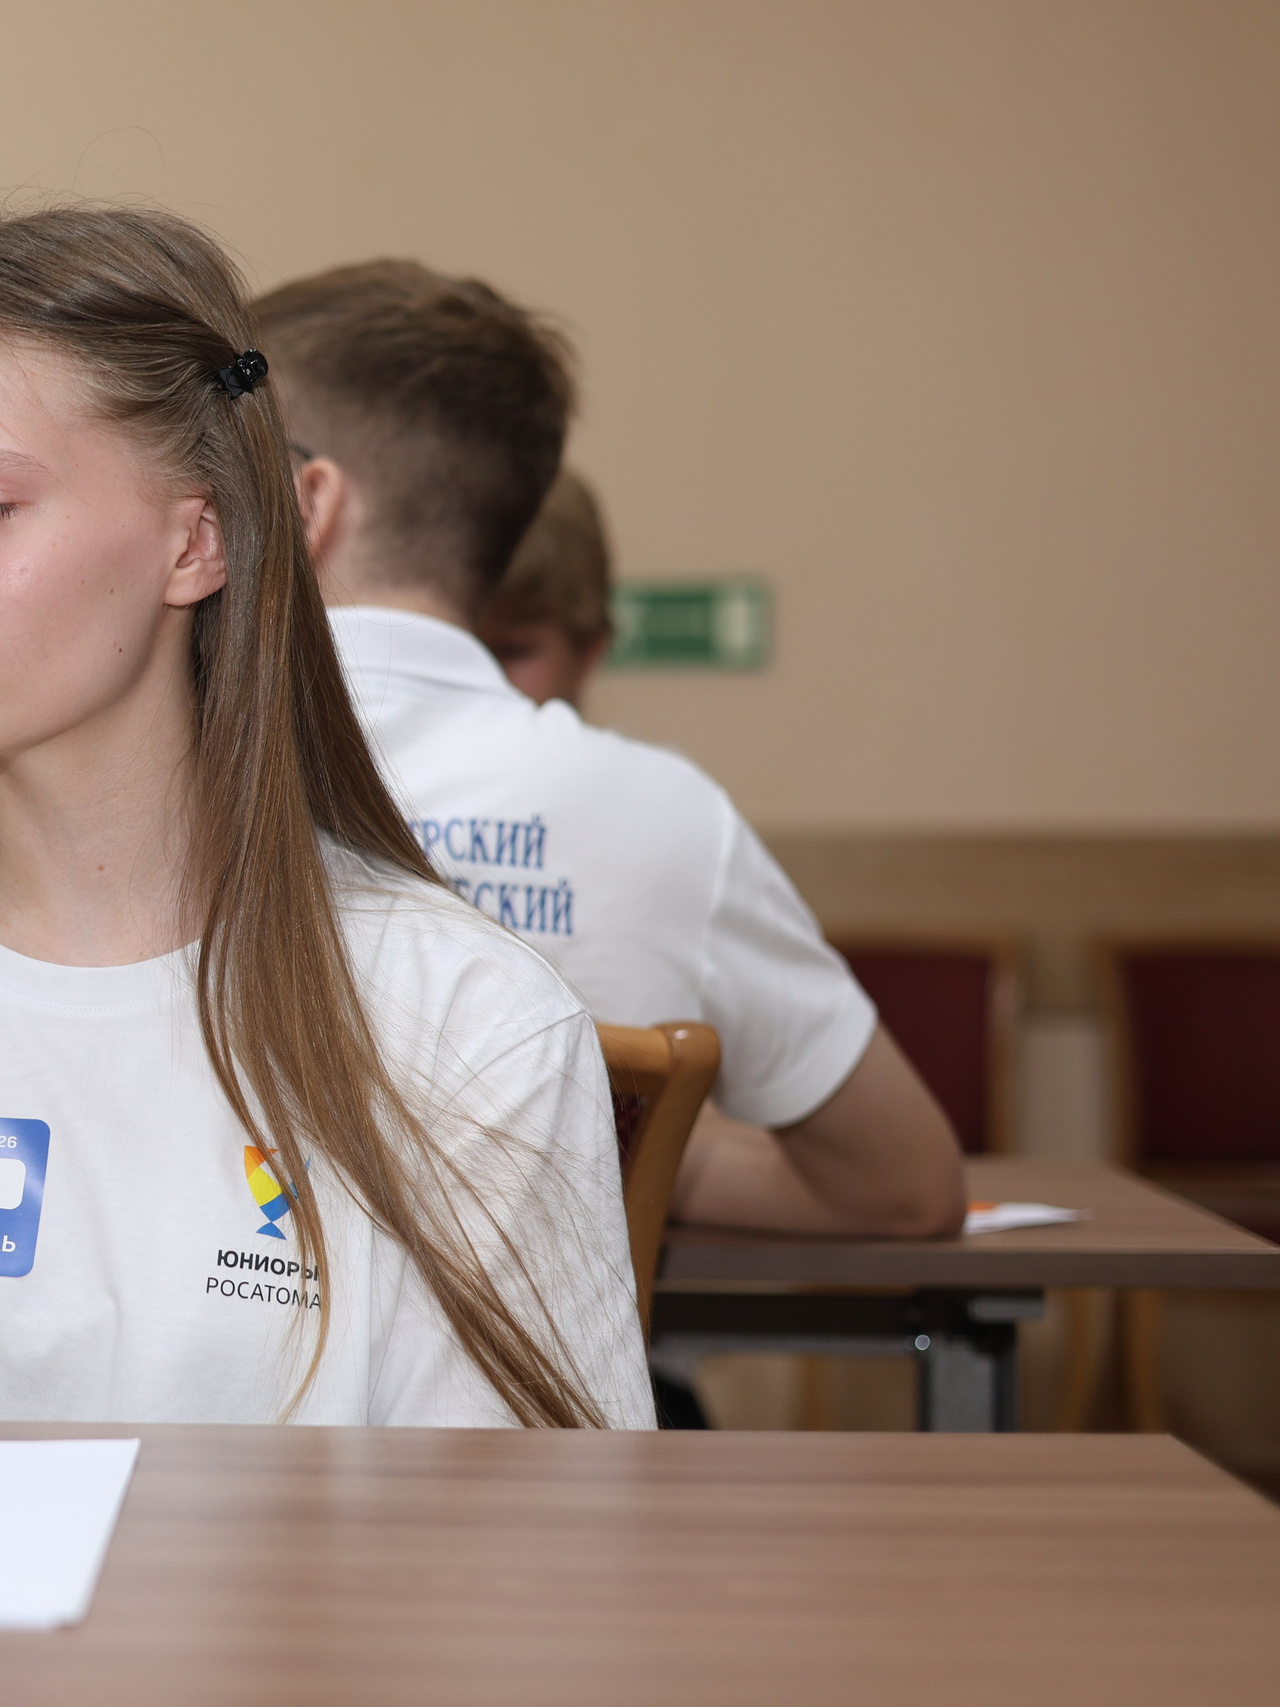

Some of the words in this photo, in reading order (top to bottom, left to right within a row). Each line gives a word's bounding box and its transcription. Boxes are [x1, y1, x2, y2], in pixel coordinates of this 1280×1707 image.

[409, 814, 546, 869] РСКИЙ
[453, 877, 573, 936] СКИЙ
[217, 1249, 318, 1281] ЮНИОРЫ
[206, 1277, 322, 1311] РОСАТОМА
